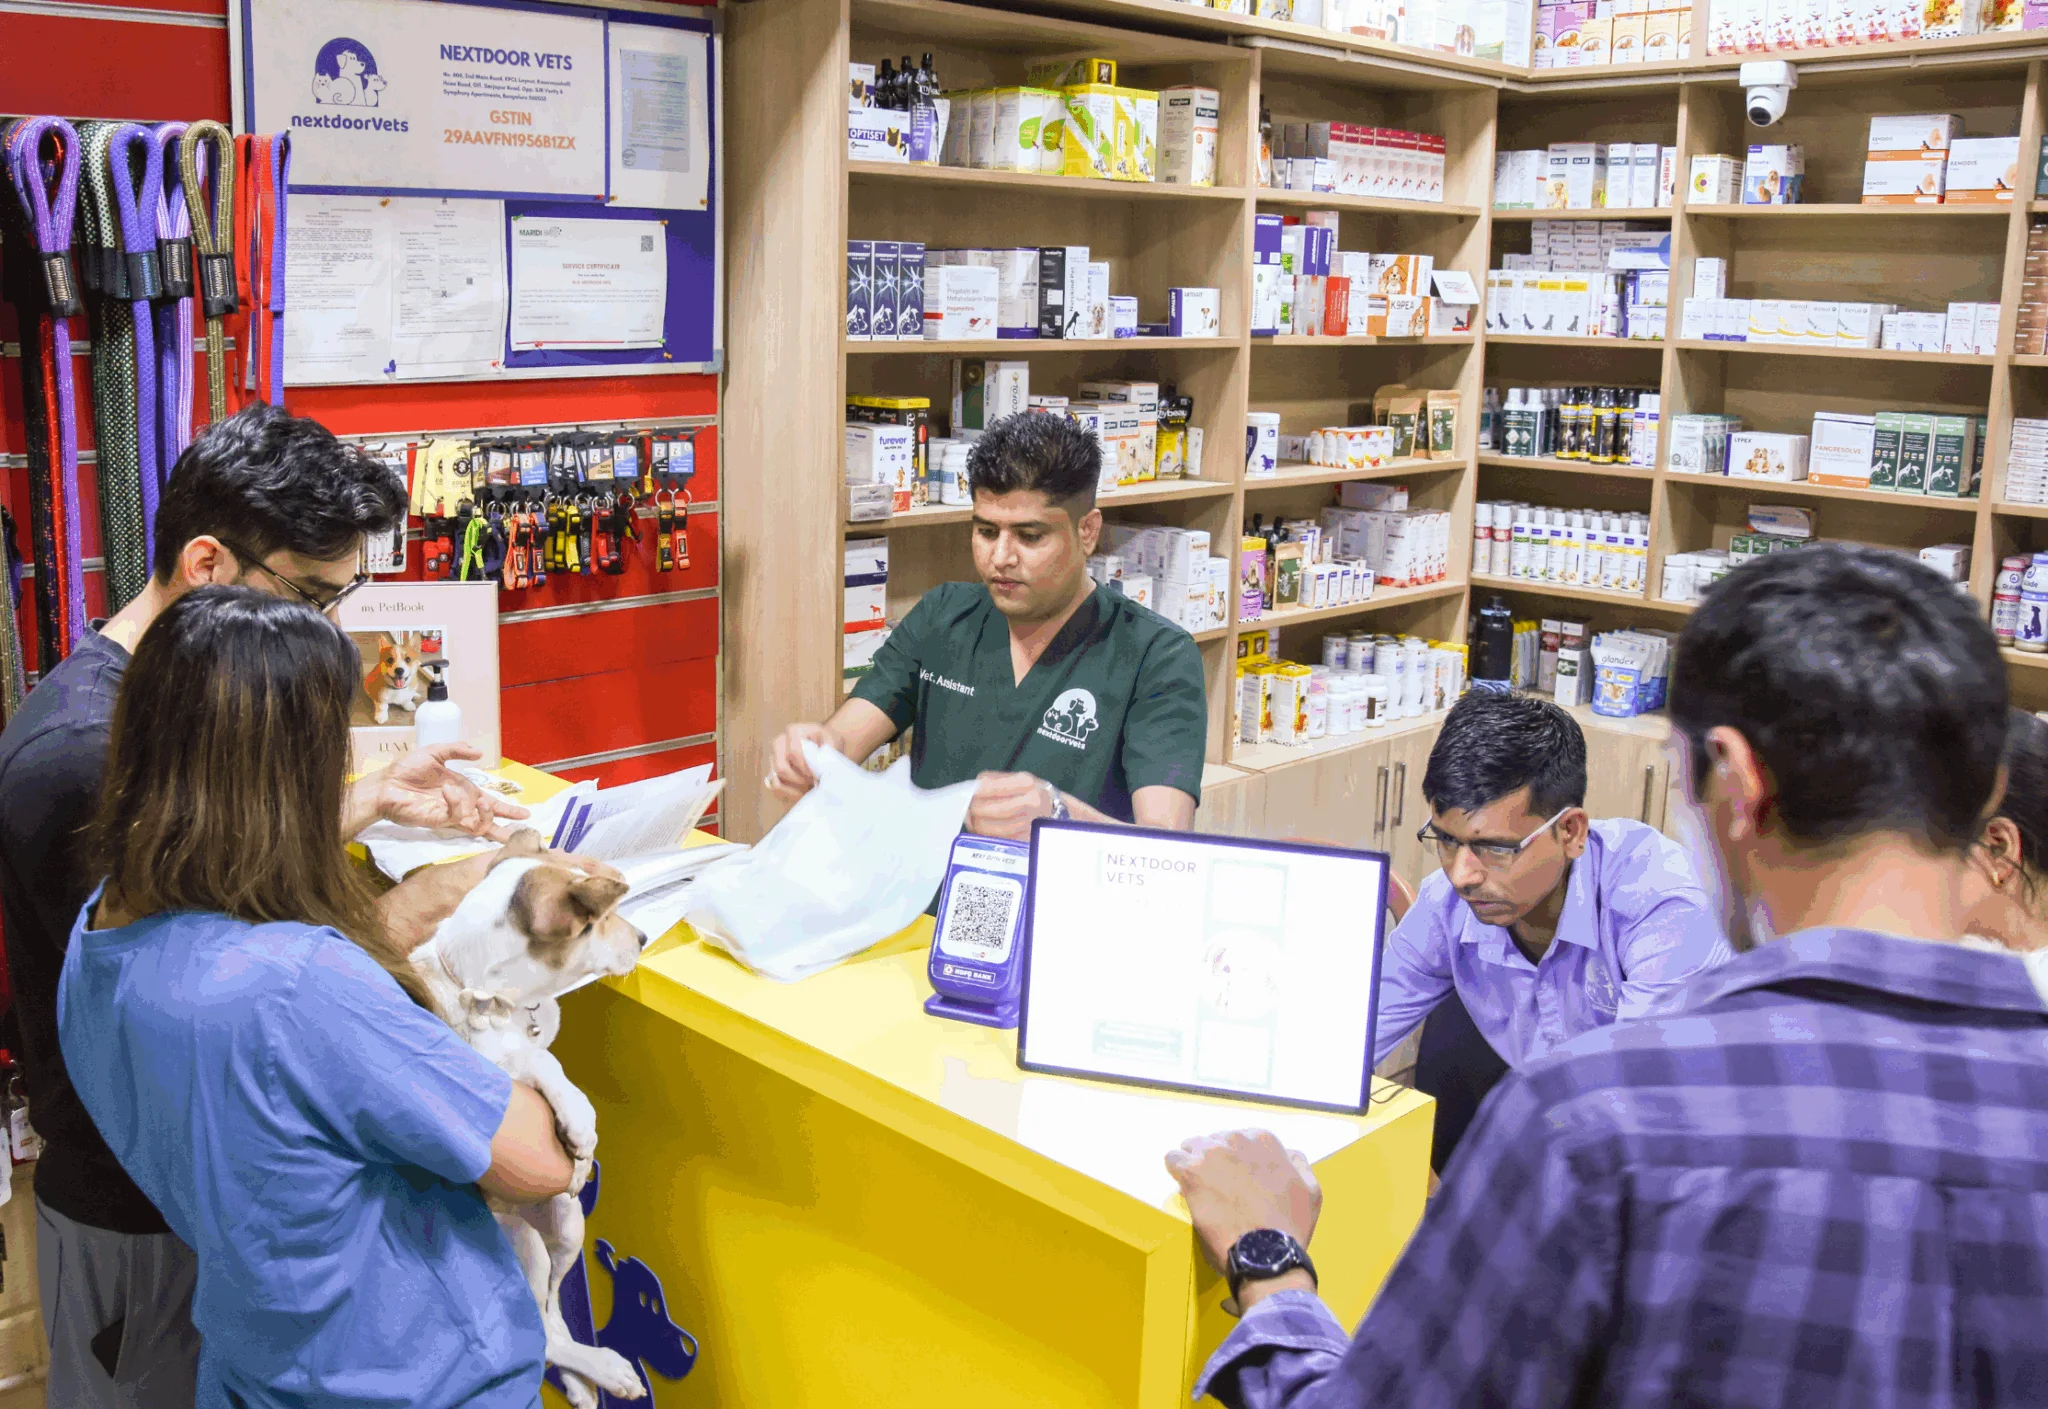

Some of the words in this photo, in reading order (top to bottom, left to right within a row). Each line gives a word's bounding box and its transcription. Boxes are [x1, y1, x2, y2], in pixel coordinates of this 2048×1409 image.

[440, 44, 531, 67] NEXTDOOR
[534, 52, 573, 70] VETS
[291, 114, 409, 132] nextdoorVets
[489, 109, 532, 126] GSTIN
[443, 128, 576, 150] 29AAVFN1956B1ZX
[850, 129, 884, 140] OPTISET
[1369, 259, 1386, 268] PEA
[1391, 300, 1415, 310] K9PEA
[879, 436, 907, 445] furever
[1815, 444, 1862, 454] PANCRESOLVE
[361, 604, 375, 613] my
[379, 602, 425, 612] PetBook
[1601, 654, 1636, 666] glandex
[920, 668, 936, 684] Vet.
[936, 675, 975, 696] Assistant
[379, 742, 409, 752] LUNA
[1106, 852, 1197, 875] NEXTDOOR
[1106, 872, 1145, 887] VETS
[954, 968, 972, 978] HDFC
[973, 972, 992, 982] BANK
